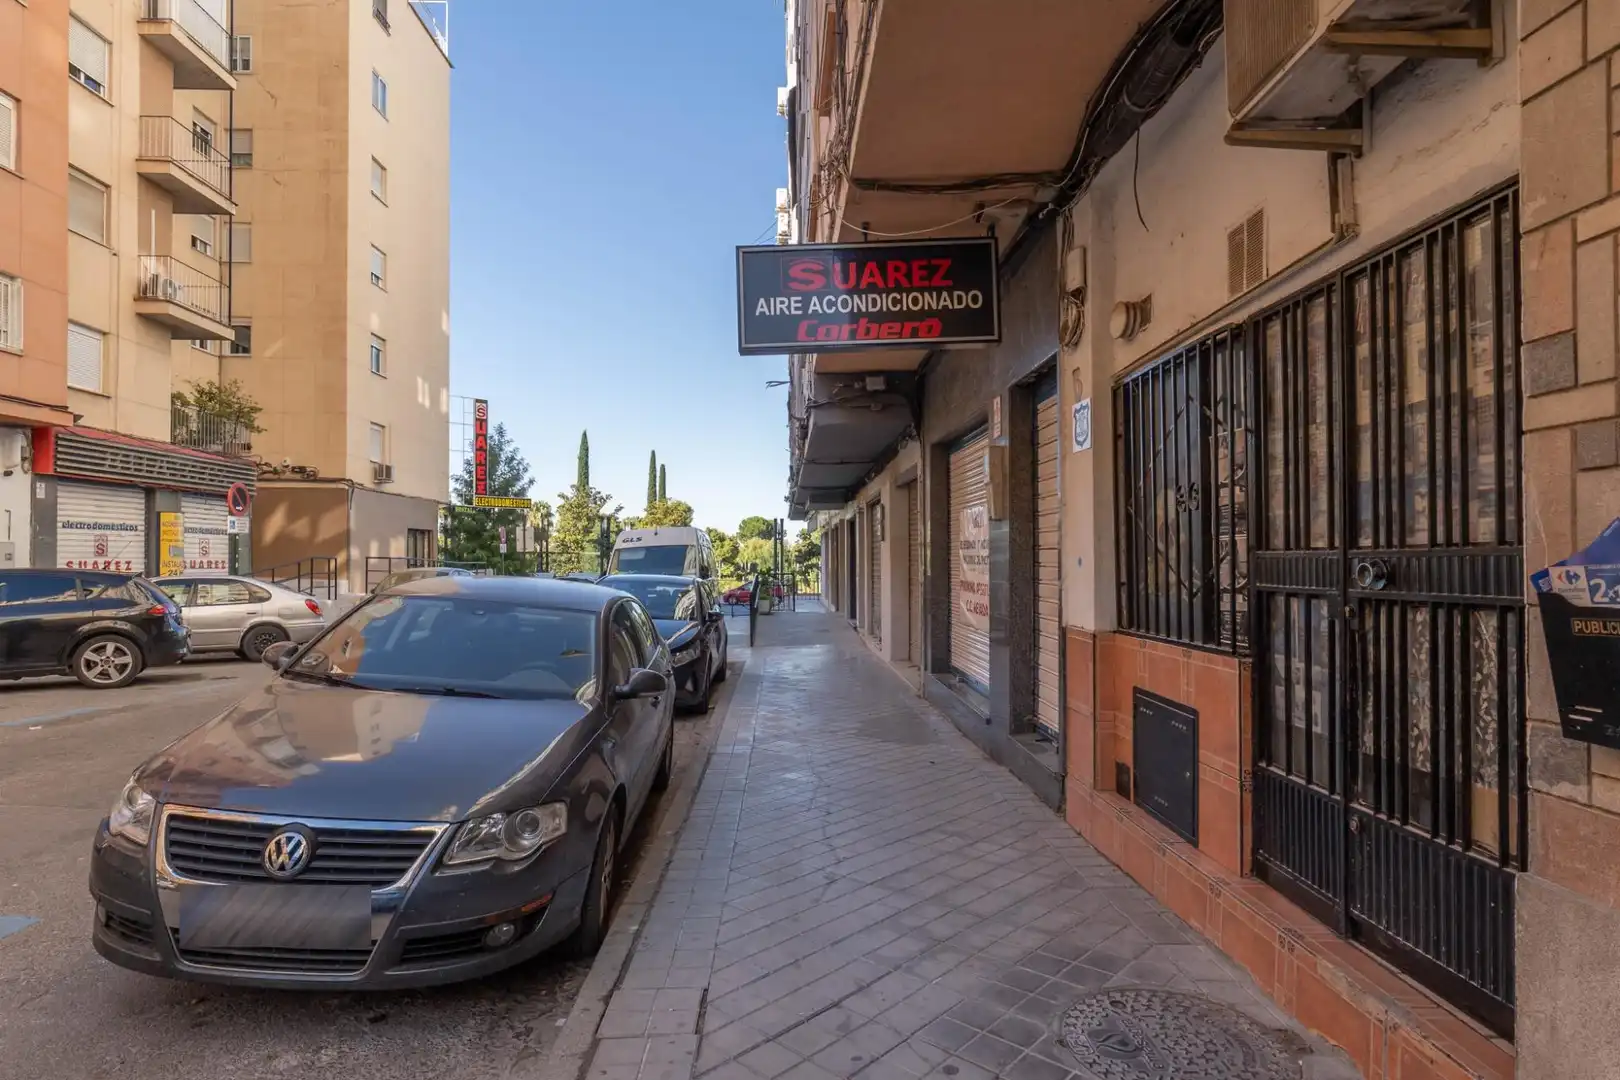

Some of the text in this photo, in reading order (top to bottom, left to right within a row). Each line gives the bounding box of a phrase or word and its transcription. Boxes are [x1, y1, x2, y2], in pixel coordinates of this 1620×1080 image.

[787, 258, 953, 291] SUAREZ
[755, 290, 983, 316] AIRE ACONDICIONADO
[475, 407, 487, 495] SUAREZ
[622, 536, 643, 544] GLS
[182, 559, 227, 570] SUAREZ
